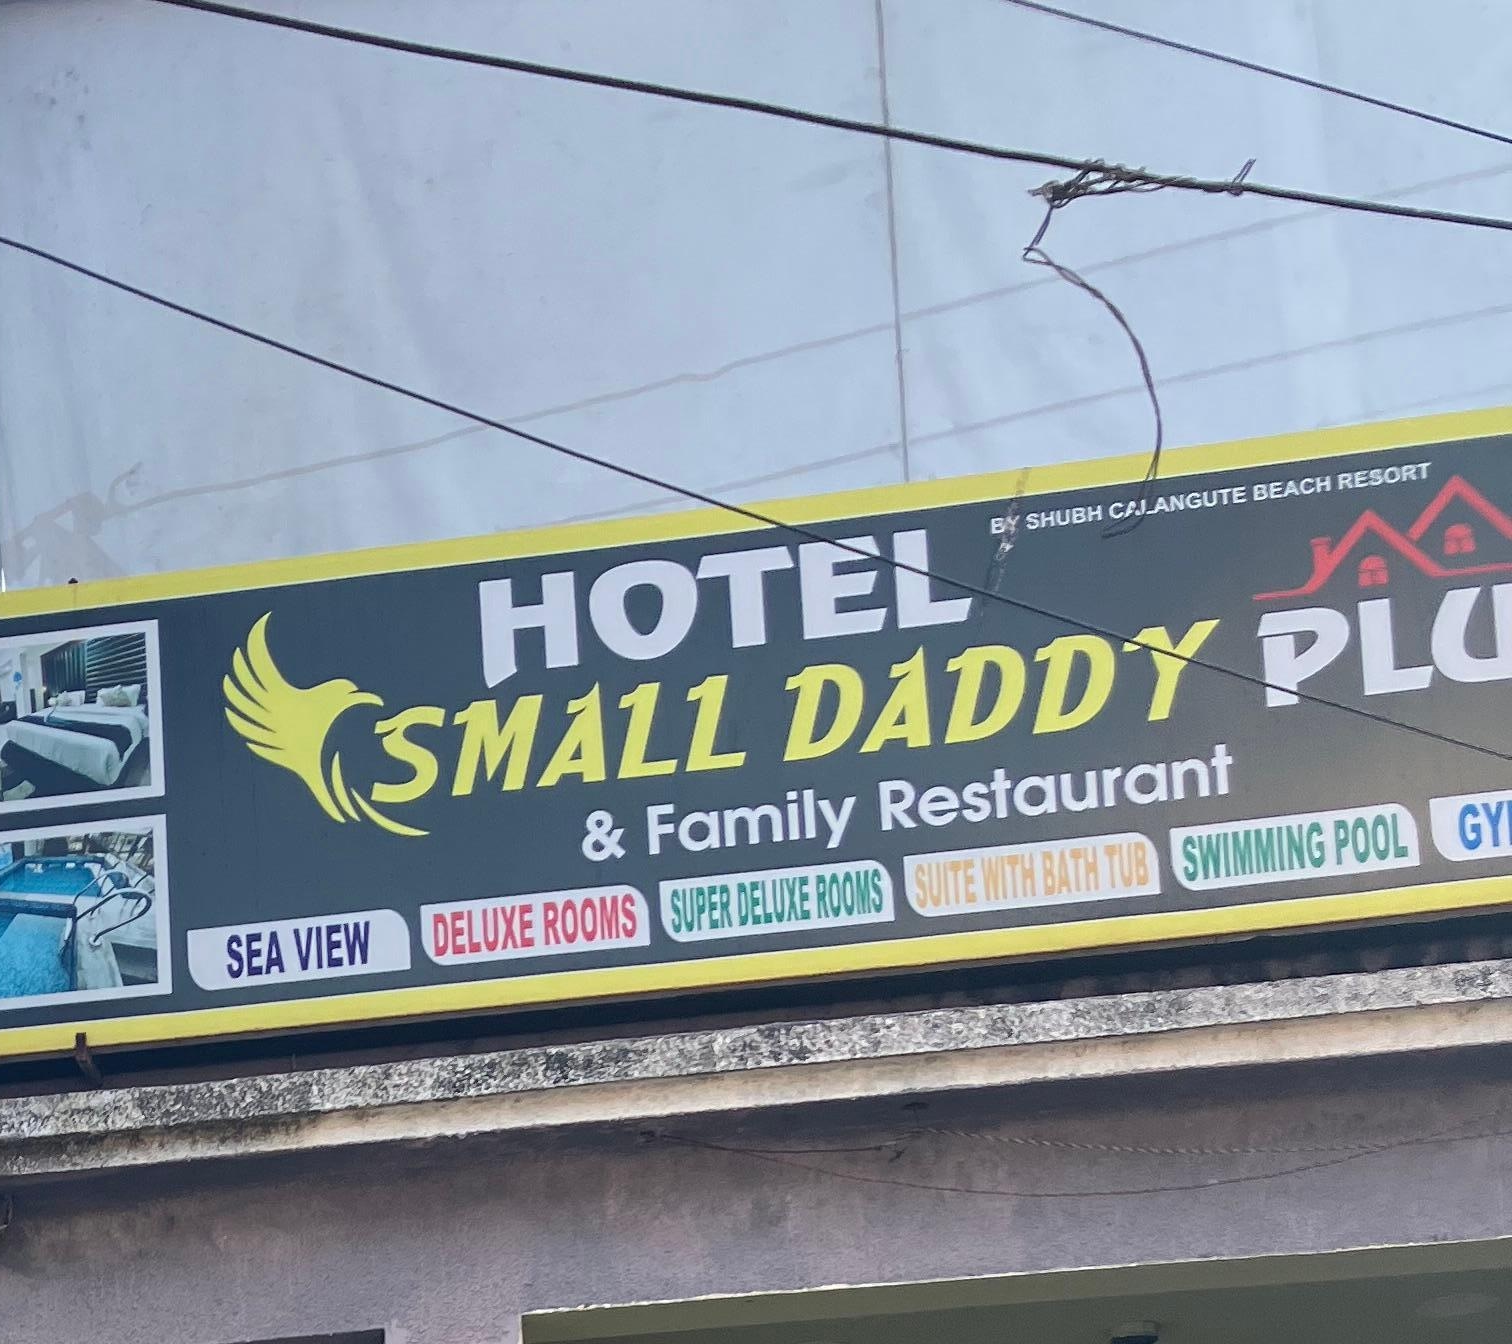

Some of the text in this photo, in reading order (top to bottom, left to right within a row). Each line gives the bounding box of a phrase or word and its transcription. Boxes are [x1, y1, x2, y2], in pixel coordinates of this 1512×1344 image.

[990, 462, 1432, 534] BY SHUBH CALANGUTE BEACH RESORT
[479, 528, 973, 688] HOTEL
[371, 675, 748, 803] SMALL
[783, 618, 1221, 762] DADDY
[580, 744, 1234, 863] & Family Restaurant
[914, 841, 1150, 910] SUITE WITH BATH TUB
[1181, 813, 1409, 883] SWIMMING POOL
[432, 894, 638, 958] DELUXE ROOMS
[670, 868, 884, 934] SUPER DELUXE ROOMS
[226, 921, 371, 979] SEA VIEW
